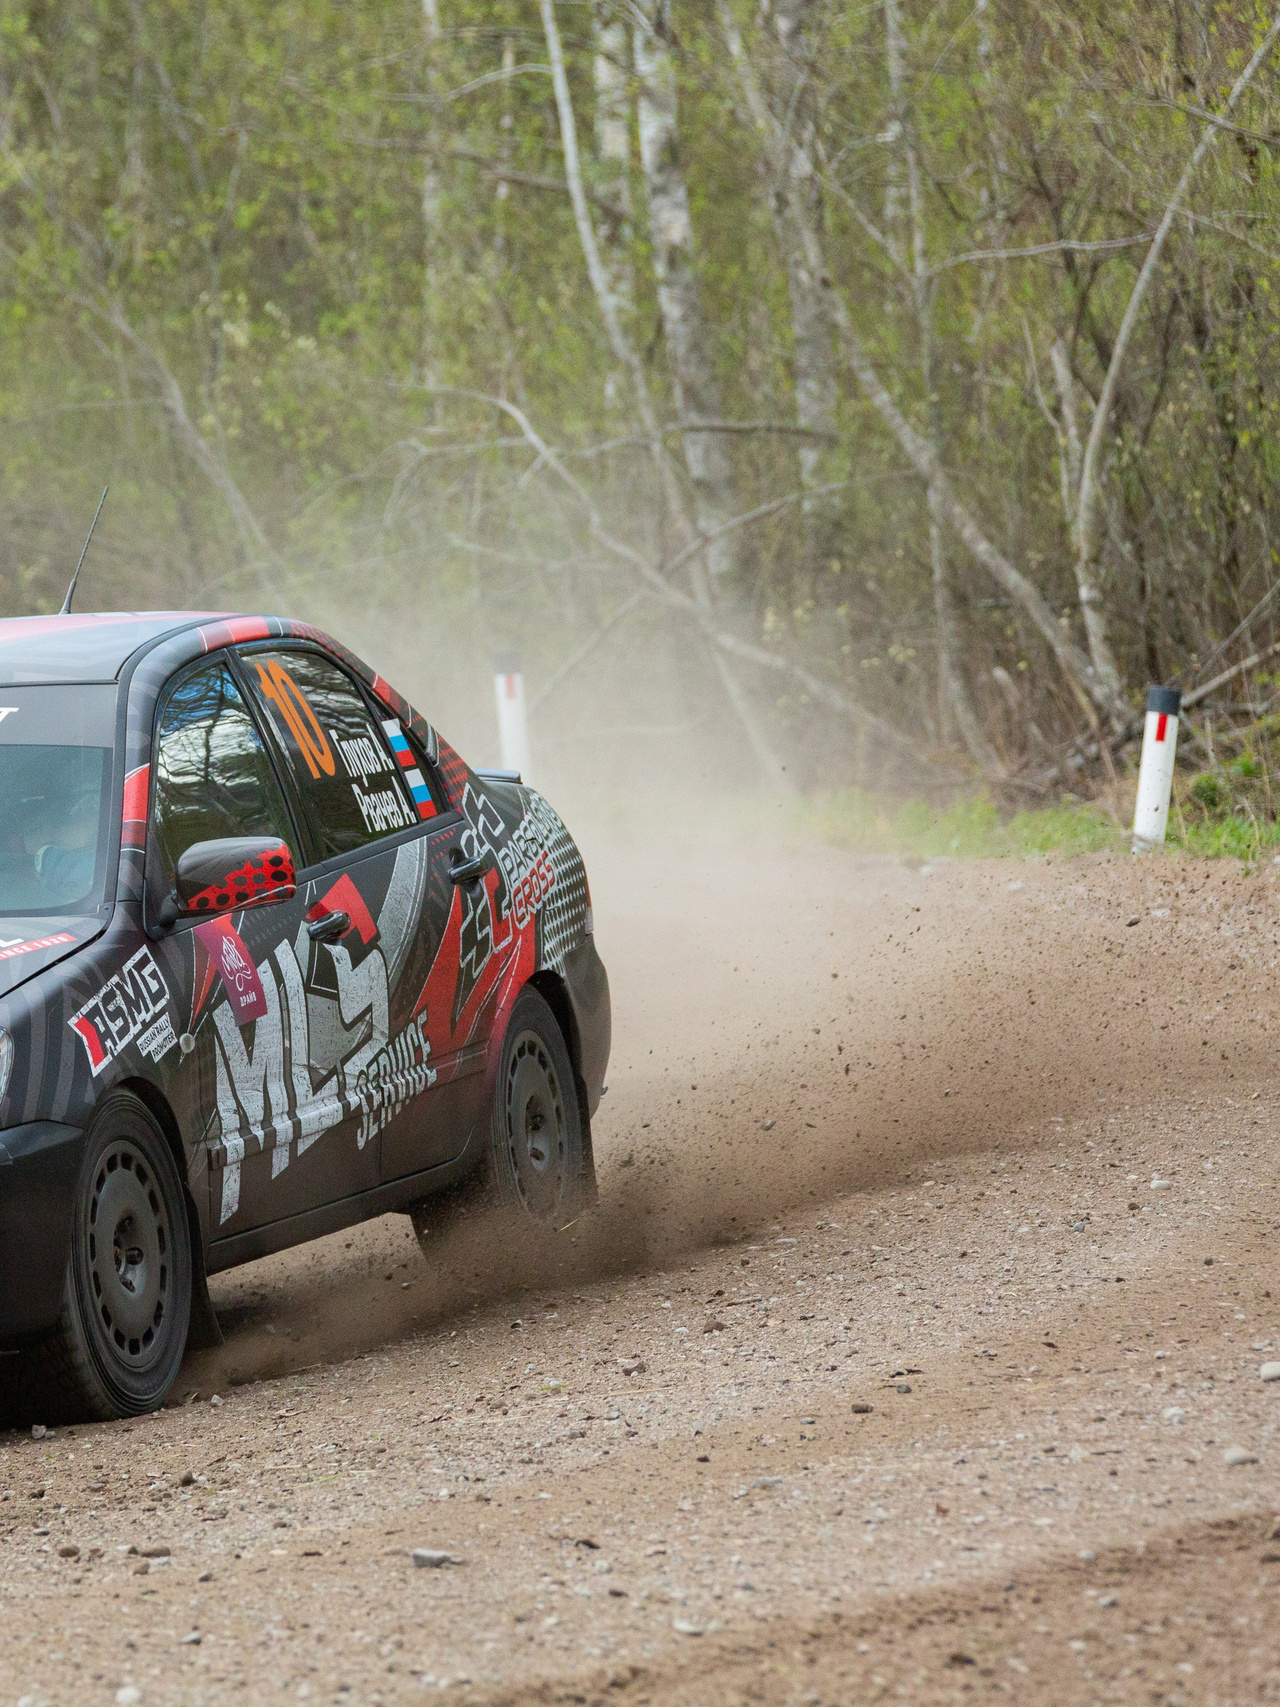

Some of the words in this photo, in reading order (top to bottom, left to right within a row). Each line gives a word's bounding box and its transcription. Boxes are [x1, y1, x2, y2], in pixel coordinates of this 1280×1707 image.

[254, 660, 335, 779] 10
[329, 729, 382, 787] Глухов
[351, 784, 404, 833] Рвачев
[512, 850, 556, 924] CROSS
